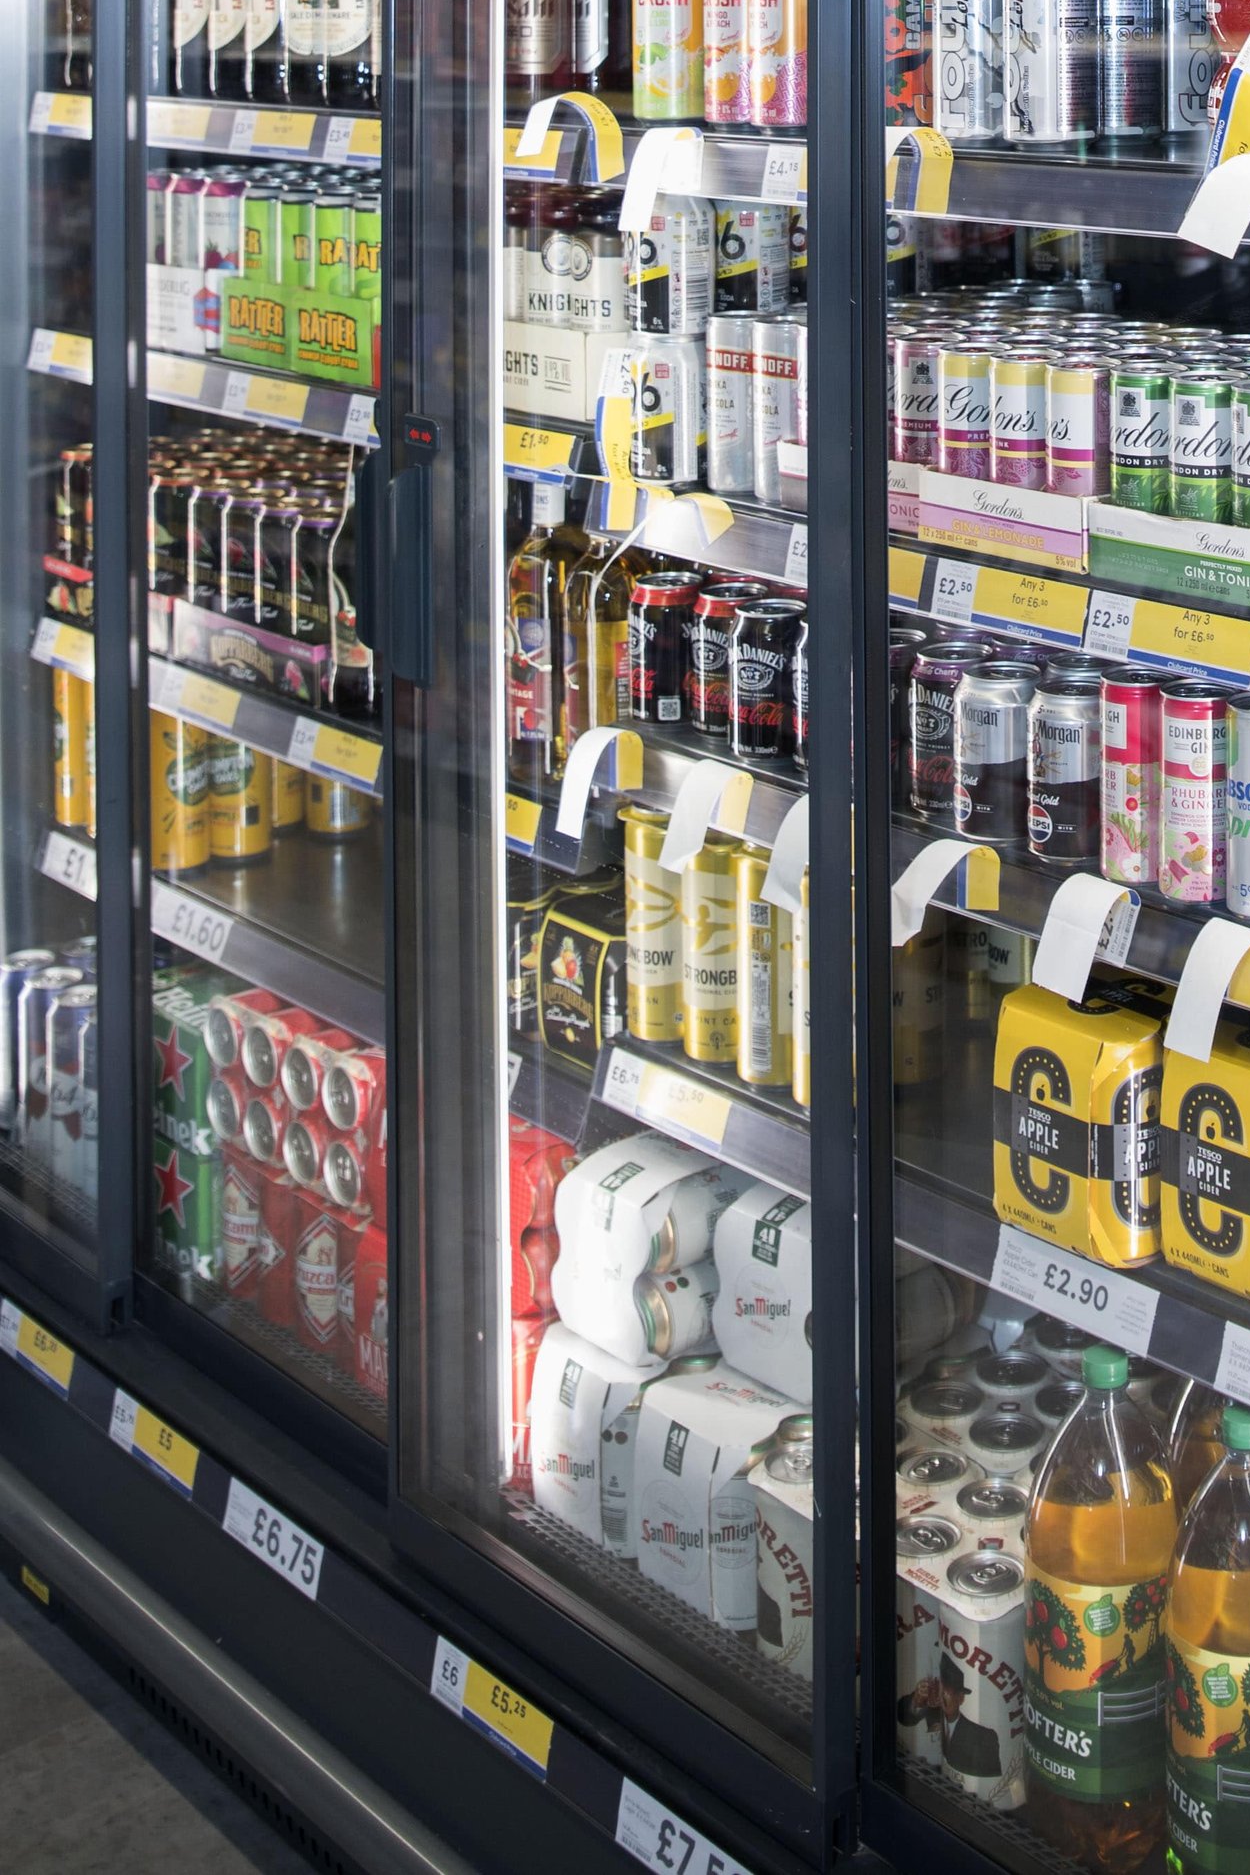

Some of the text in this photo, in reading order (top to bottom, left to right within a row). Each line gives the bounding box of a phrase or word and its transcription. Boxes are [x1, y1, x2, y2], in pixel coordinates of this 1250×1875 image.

[768, 160, 799, 176] £4.15
[1143, 457, 1165, 467] DRY
[1203, 467, 1225, 478] DRY
[982, 526, 1045, 551] LEMONADE
[1184, 565, 1208, 581] GIN
[1208, 569, 1218, 583] &
[938, 577, 973, 596] £2.50
[1019, 577, 1046, 592] Any 3
[1011, 593, 1025, 606] for
[1092, 609, 1130, 629] £2.50
[1182, 609, 1211, 625] Any 3
[1173, 626, 1215, 643] for £6.50
[933, 667, 959, 678] Cherry
[1167, 661, 1208, 677] Clubcard Price
[1038, 720, 1083, 746] Morgan
[170, 903, 226, 953] £1.60
[683, 964, 738, 987] STRONGB
[1027, 1107, 1052, 1122] TESCO
[1018, 1116, 1060, 1150] APPLE
[1029, 1143, 1049, 1156] CIDER
[1197, 1145, 1223, 1161] TESCO
[1187, 1156, 1231, 1191] APPLE
[1198, 1181, 1221, 1197] CIDER
[1042, 1261, 1110, 1313] £2.90
[158, 1429, 174, 1451] £5
[251, 1507, 318, 1586] £6.75
[441, 1659, 459, 1687] £6
[490, 1684, 527, 1719] £5.25
[1043, 1758, 1076, 1782] CIDER
